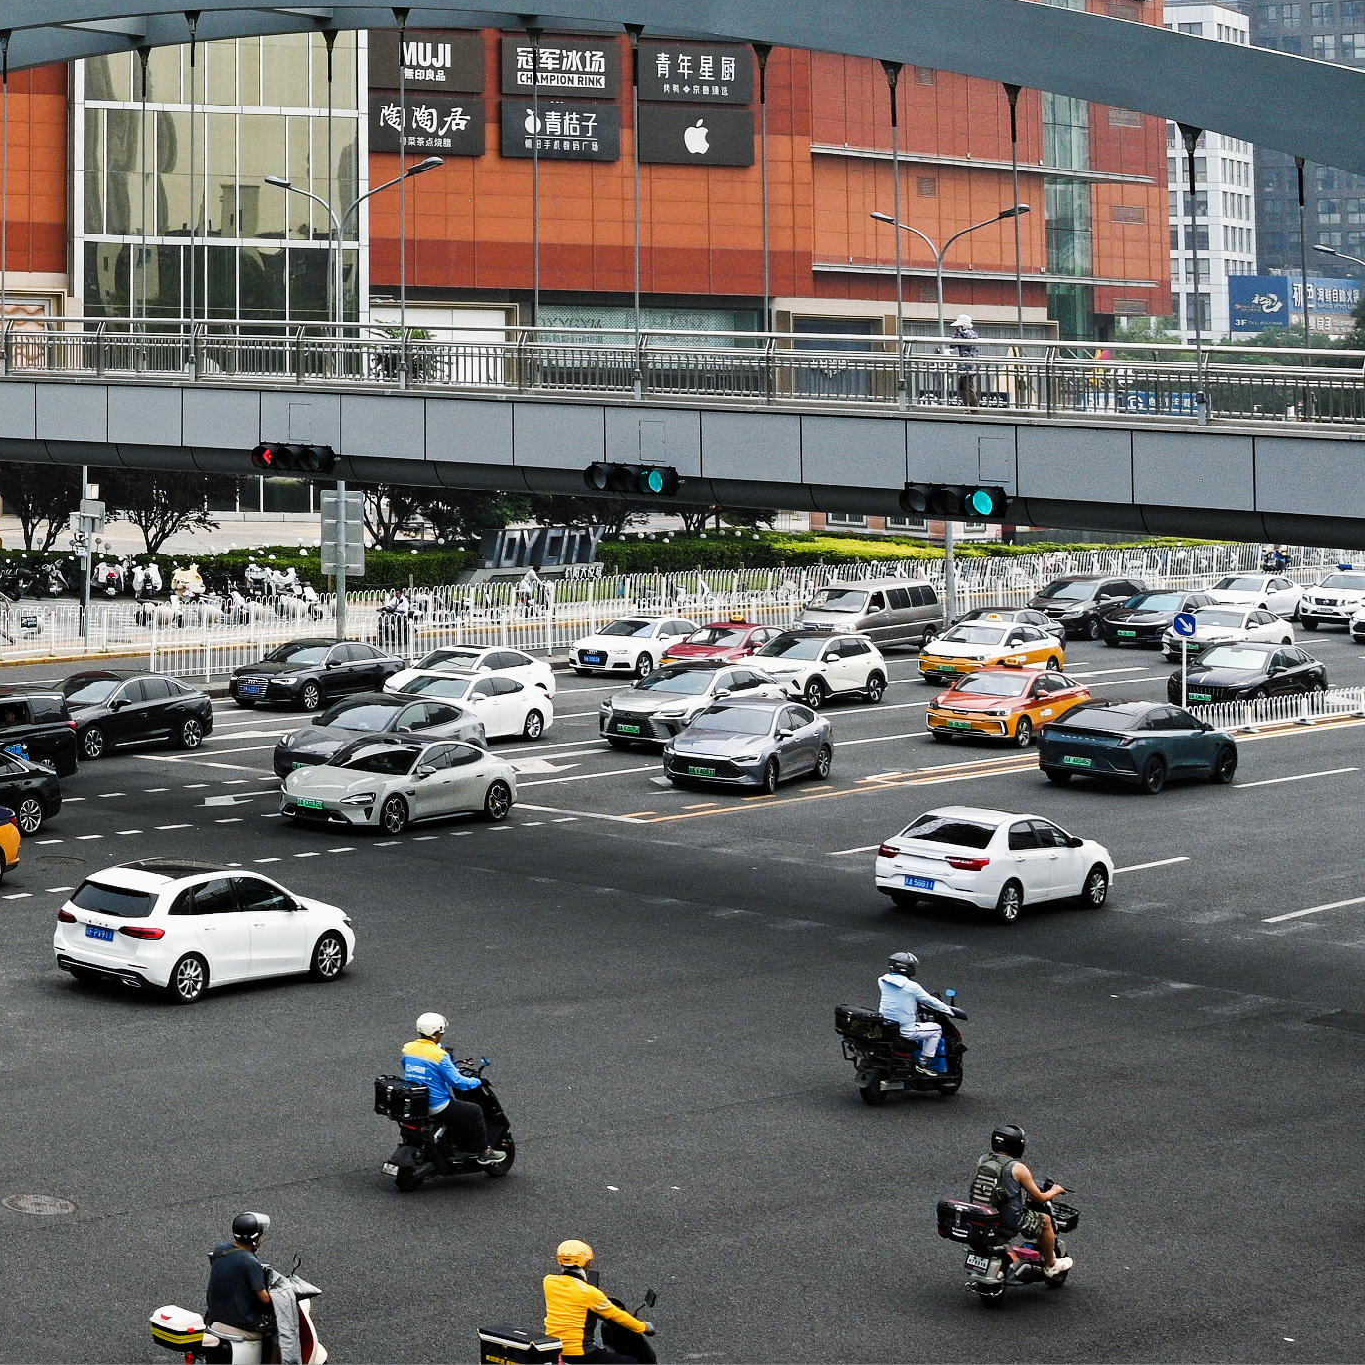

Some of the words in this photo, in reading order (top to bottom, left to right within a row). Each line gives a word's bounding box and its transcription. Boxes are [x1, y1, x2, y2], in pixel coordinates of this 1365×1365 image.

[399, 41, 451, 67] MUJI
[517, 47, 605, 73] 冠军冰场
[655, 52, 735, 82] 青年星厨
[403, 68, 446, 81] 無印良品
[577, 76, 603, 87] RINK
[380, 103, 471, 136] 陶陶居
[545, 111, 598, 136] 青桔子
[1235, 318, 1248, 326] 3F
[484, 529, 541, 568] JOY
[542, 524, 606, 566] CITY
